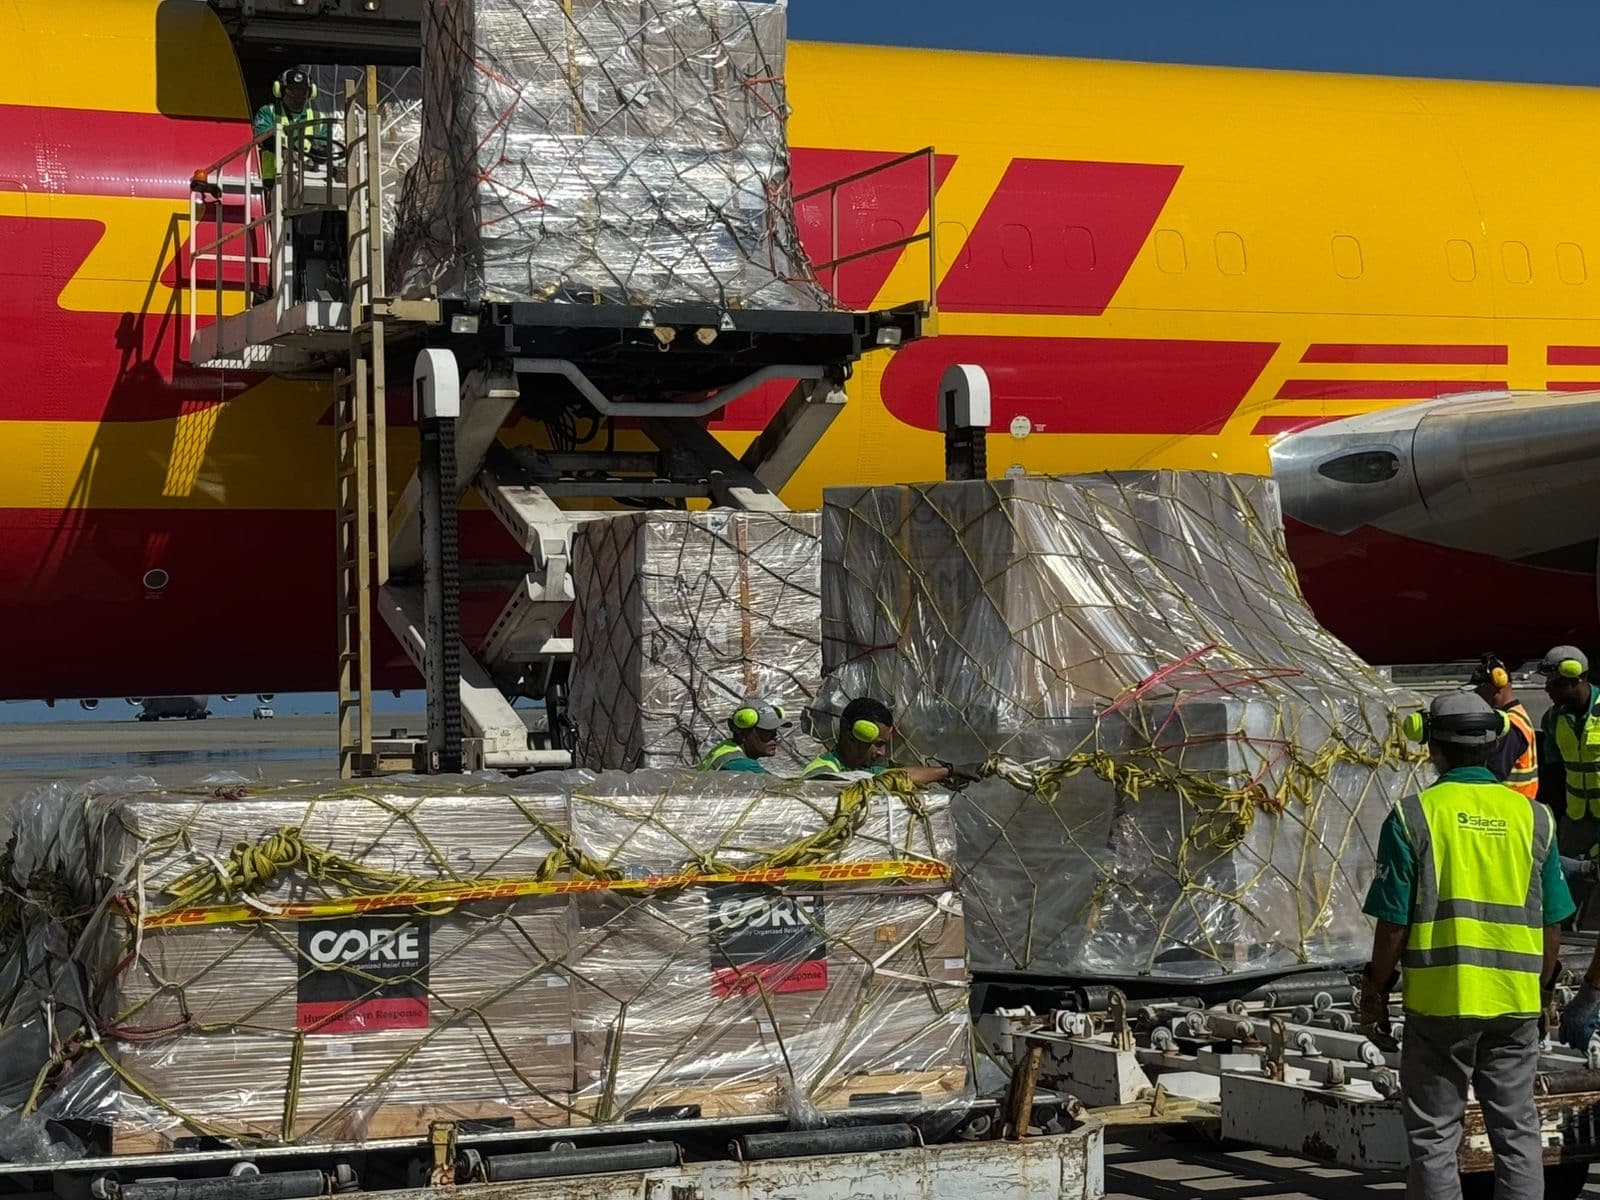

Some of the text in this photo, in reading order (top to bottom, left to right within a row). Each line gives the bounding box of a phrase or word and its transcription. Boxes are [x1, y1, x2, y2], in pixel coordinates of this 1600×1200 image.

[734, 867, 786, 883] DHL
[816, 863, 872, 879] DHL
[719, 895, 815, 929] CORE
[310, 927, 419, 962] CORE
[781, 971, 822, 982] esponse
[375, 1009, 423, 1019] Response
